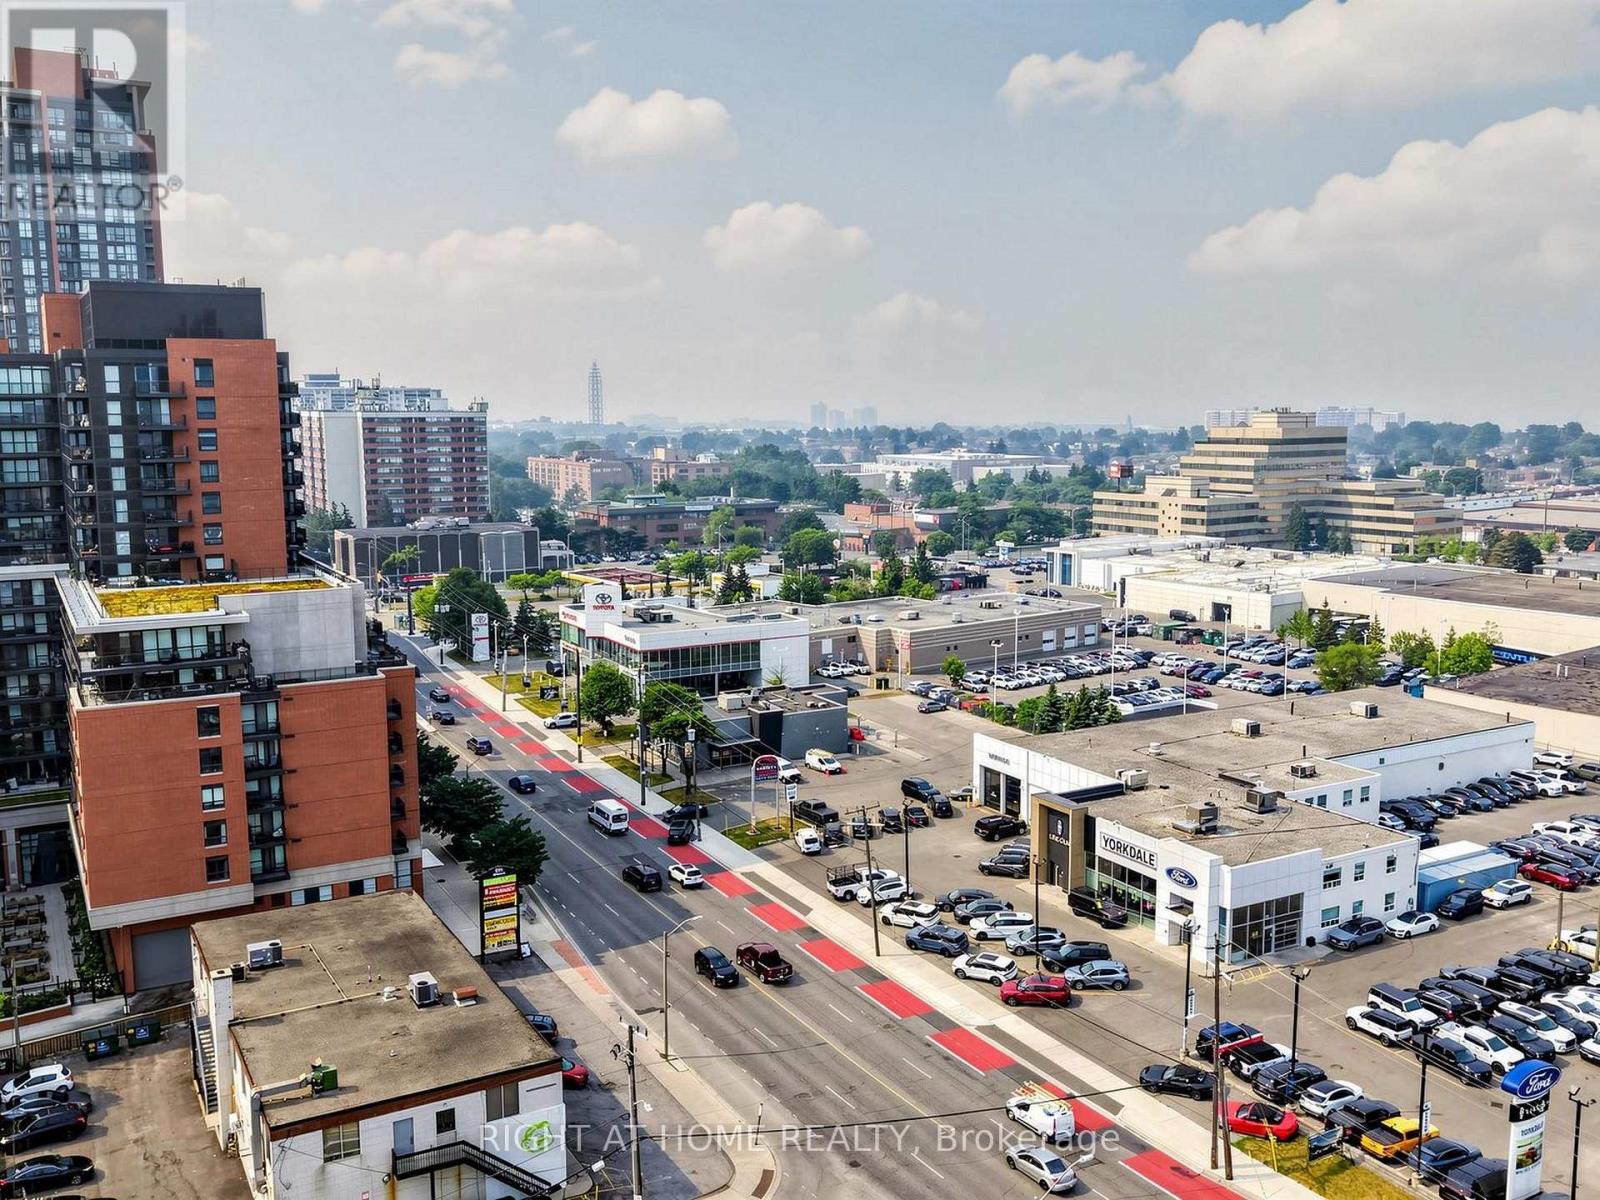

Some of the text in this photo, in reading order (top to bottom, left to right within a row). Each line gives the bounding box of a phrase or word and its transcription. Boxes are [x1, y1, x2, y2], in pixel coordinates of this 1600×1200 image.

[1102, 835, 1155, 867] YORKDALE
[1170, 869, 1190, 885] Ford
[1525, 1072, 1553, 1094] Ford
